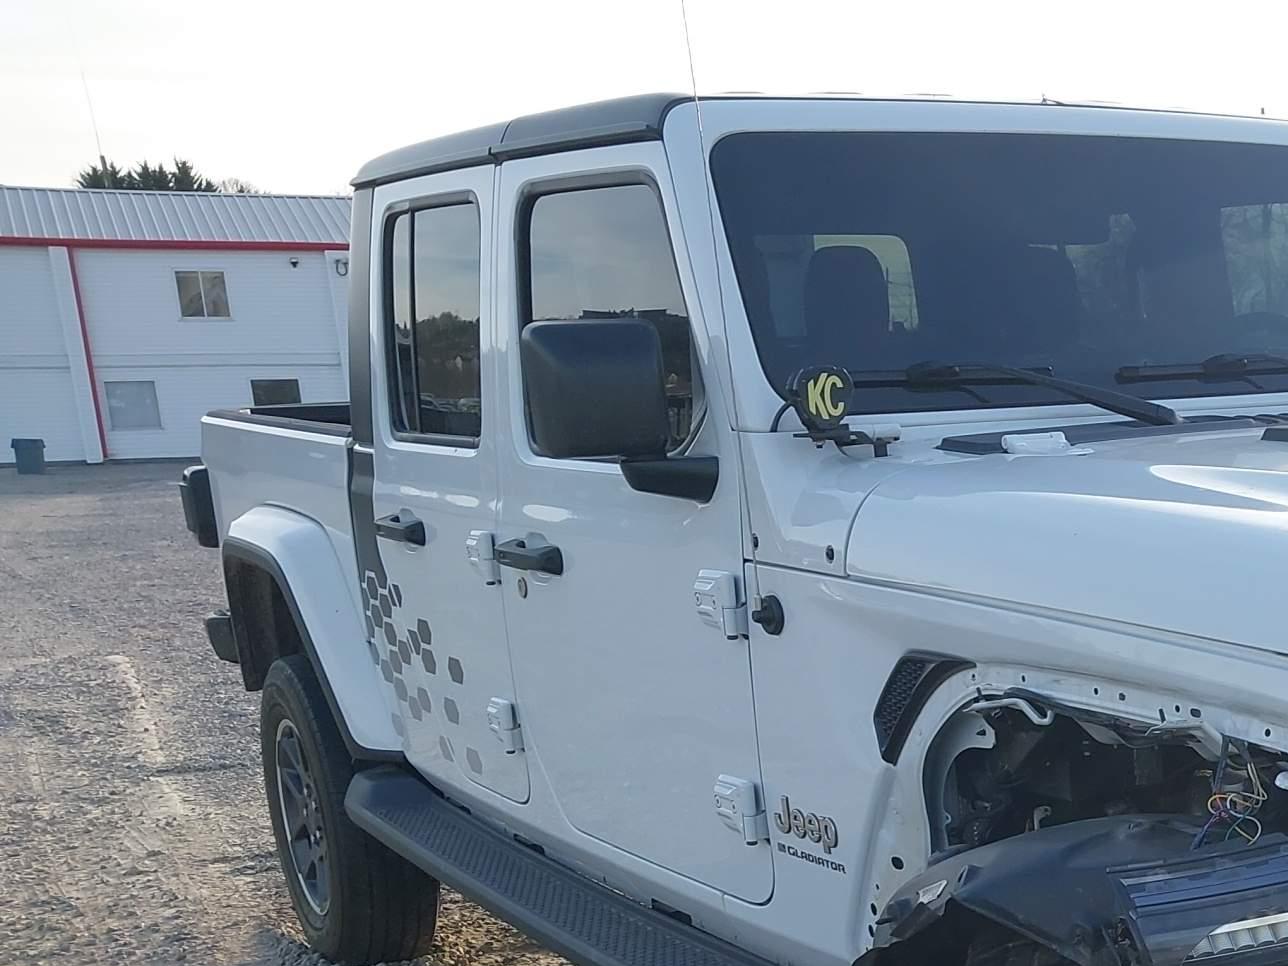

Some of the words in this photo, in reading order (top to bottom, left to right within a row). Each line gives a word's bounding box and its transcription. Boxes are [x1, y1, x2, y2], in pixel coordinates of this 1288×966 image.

[807, 372, 845, 420] KC
[774, 795, 839, 855] Jeep
[788, 846, 847, 874] GLADIATOR
